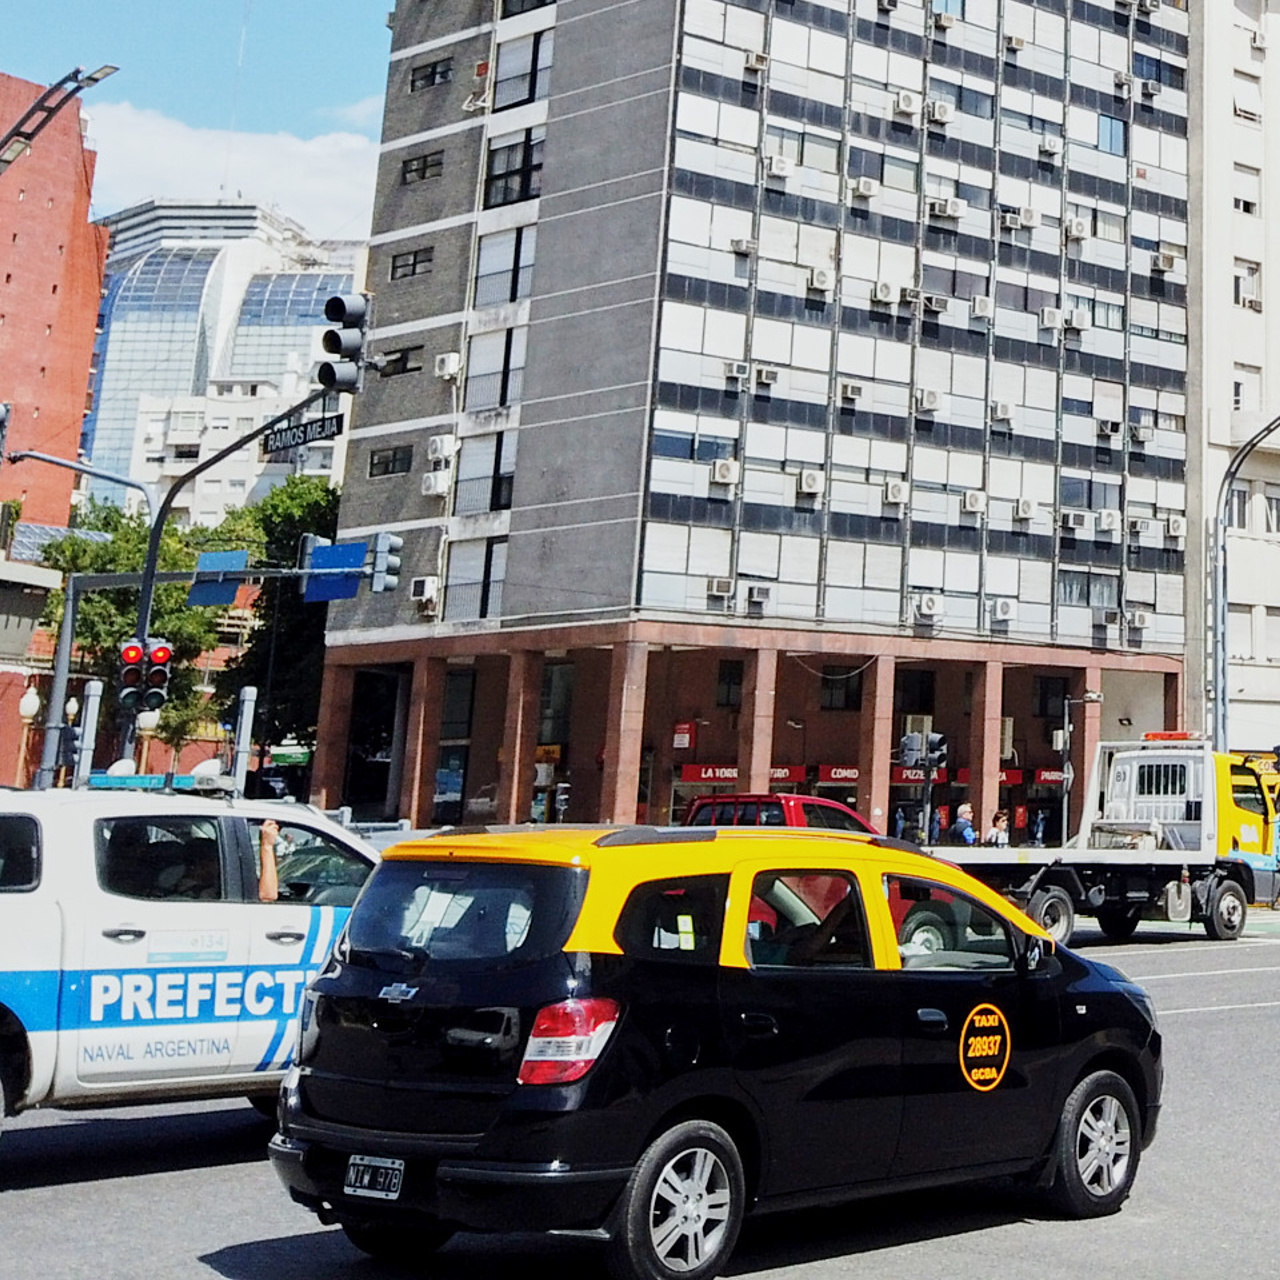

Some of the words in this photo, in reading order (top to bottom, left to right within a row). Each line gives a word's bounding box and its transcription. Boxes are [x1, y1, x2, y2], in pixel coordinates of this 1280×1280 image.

[267, 426, 305, 452] RAMOS
[306, 417, 338, 441] MEJIA
[831, 768, 859, 779] COMID
[90, 970, 318, 1021] PREFECT
[973, 1014, 999, 1028] TAXI
[83, 1042, 134, 1062] NAVAL
[143, 1038, 231, 1058] ARGENTINA
[967, 1035, 1002, 1057] 28937
[971, 1067, 998, 1080] GCBA
[376, 1169, 400, 1191] 978
